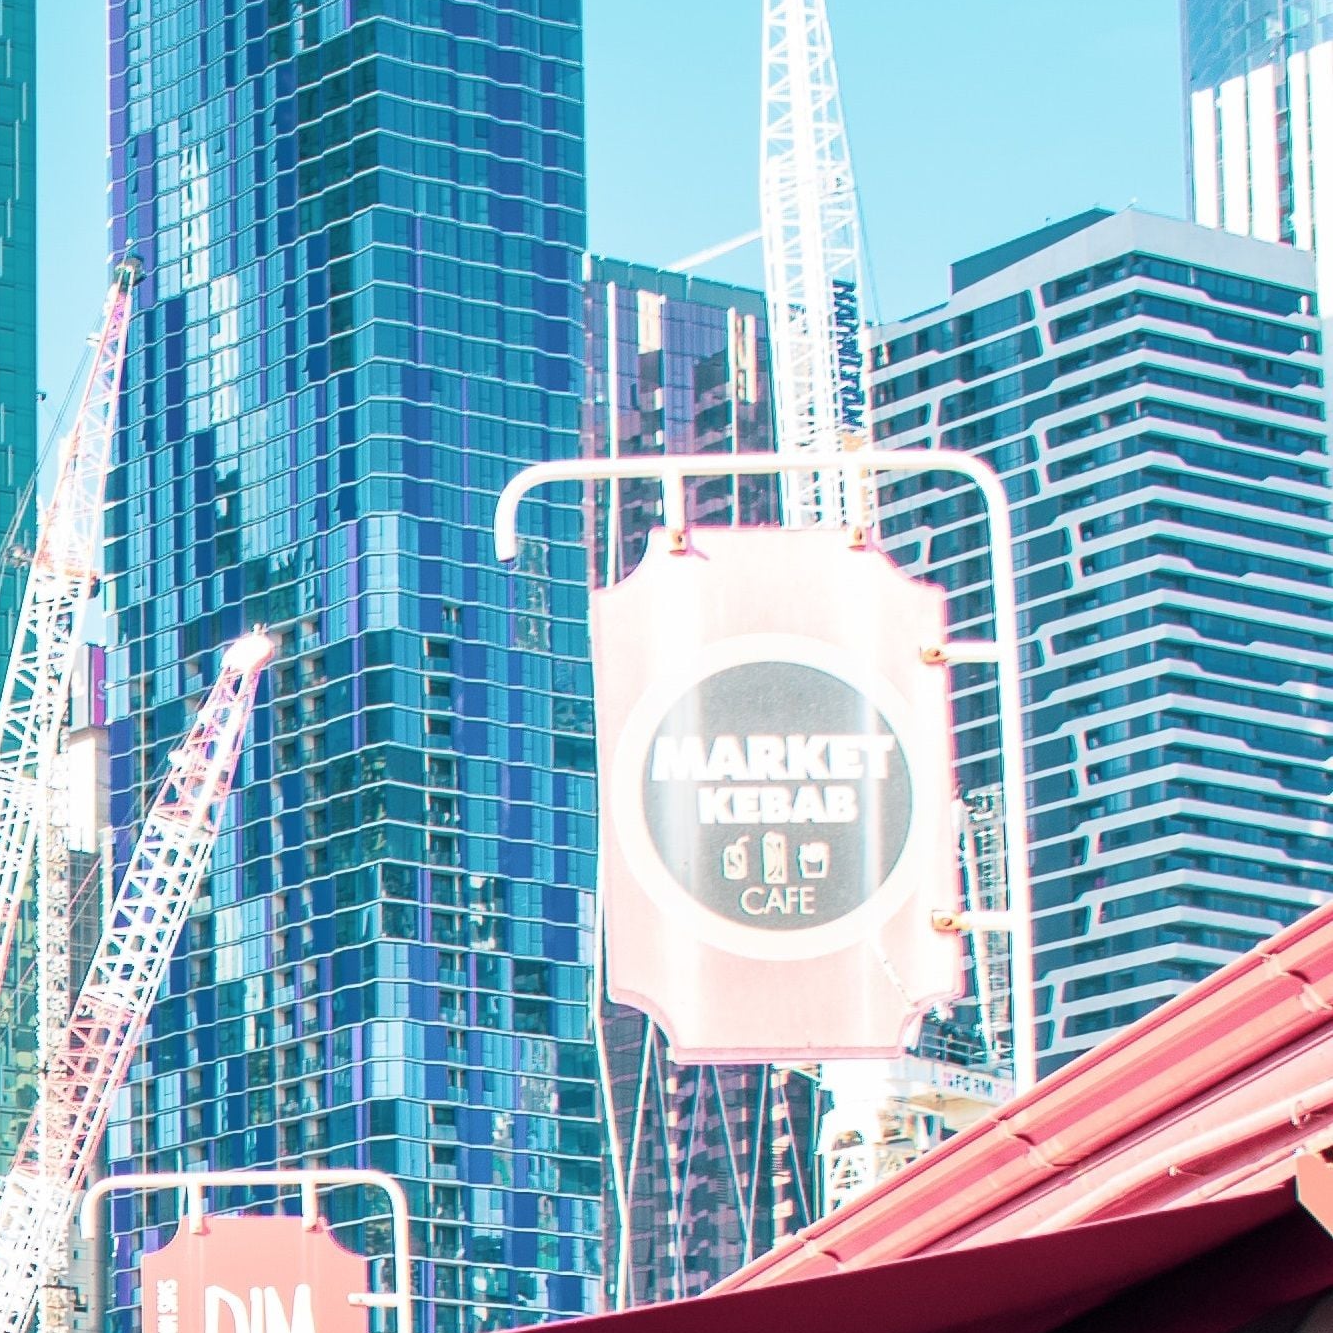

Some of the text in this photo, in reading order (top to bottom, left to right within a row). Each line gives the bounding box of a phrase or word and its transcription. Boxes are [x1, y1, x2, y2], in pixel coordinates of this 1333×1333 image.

[651, 733, 894, 782] MARKET
[698, 786, 858, 825] KEBAB
[741, 886, 816, 916] CAFE
